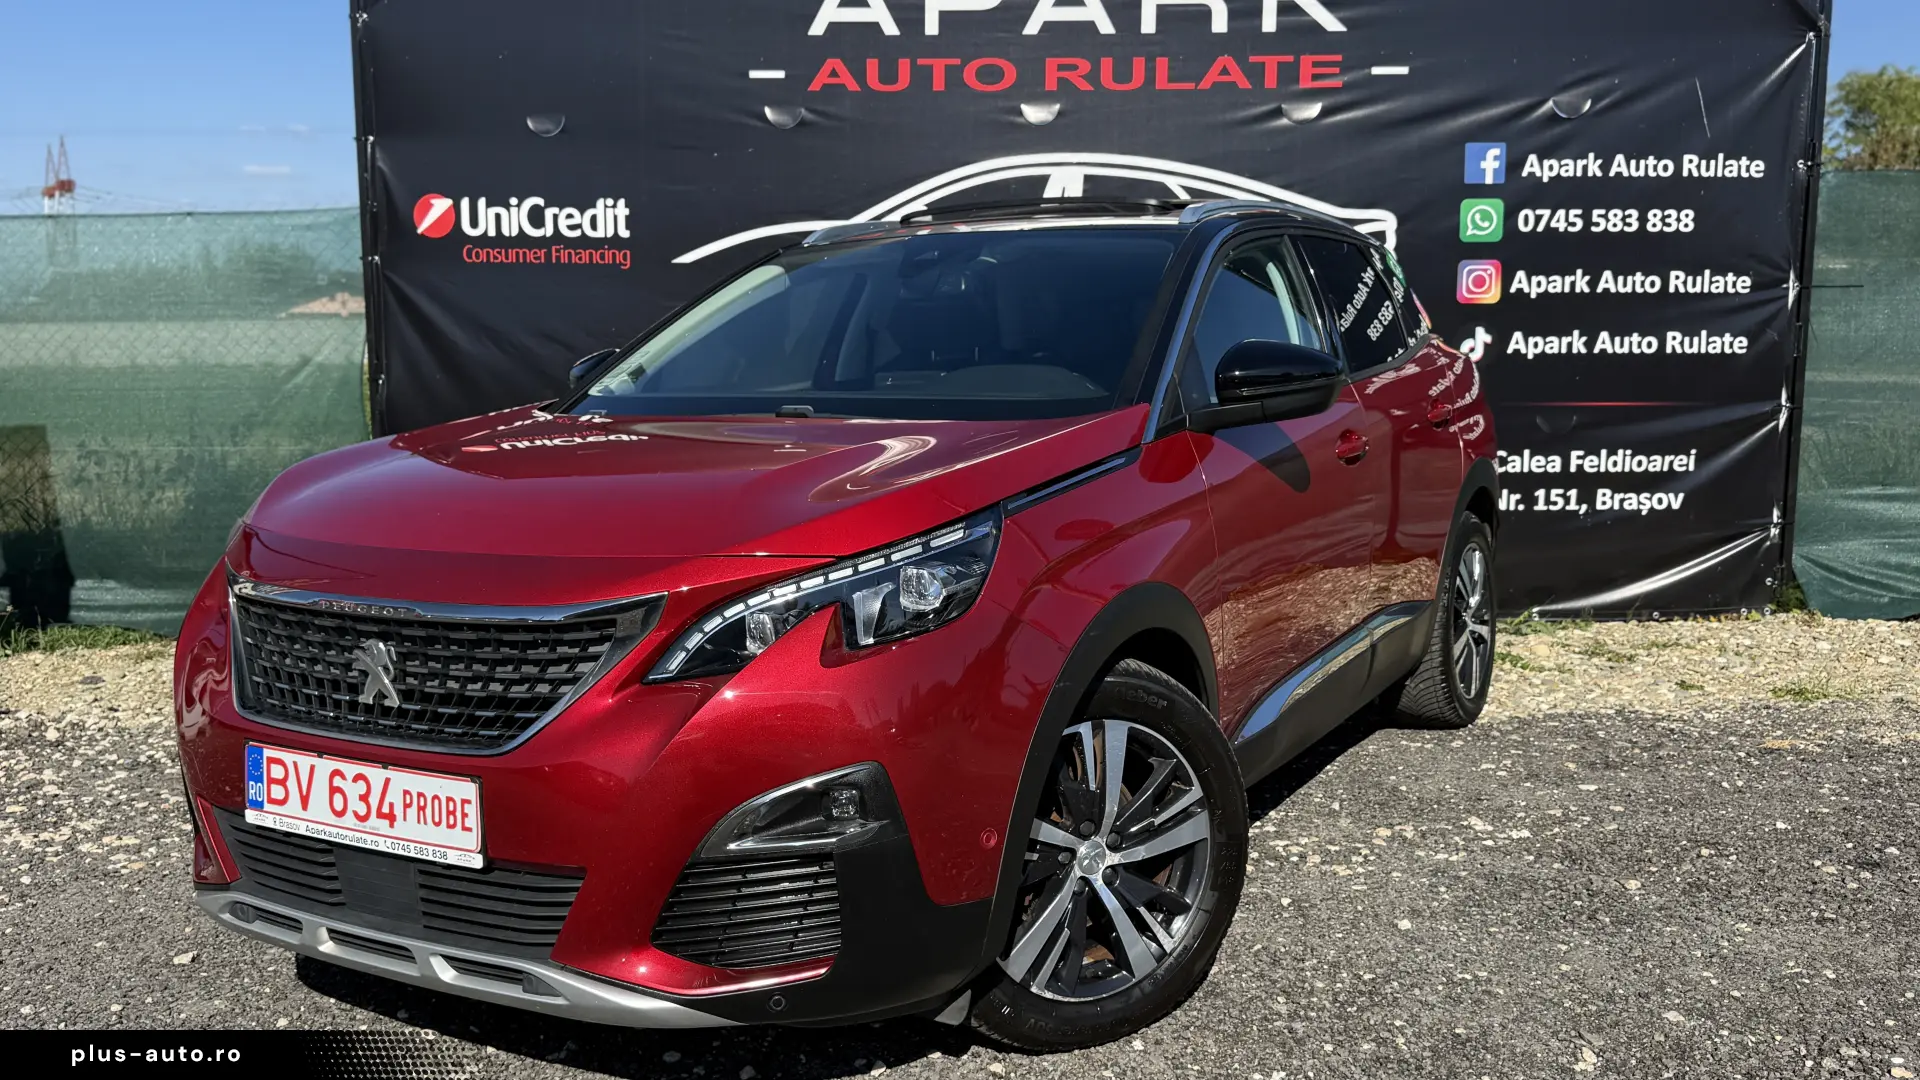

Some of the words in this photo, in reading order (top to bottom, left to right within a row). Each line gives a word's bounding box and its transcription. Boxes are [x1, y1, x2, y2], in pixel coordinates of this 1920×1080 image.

[807, 57, 1017, 92] AUTO
[1044, 54, 1344, 91] RULATE
[1521, 152, 1603, 182] Apark
[1608, 153, 1675, 178] Auto
[1682, 152, 1766, 178] Rulate
[460, 196, 631, 239] UniCredit
[1517, 208, 1584, 233] 0745
[1590, 208, 1640, 233] 583
[1646, 208, 1696, 233] 838
[463, 244, 548, 264] Consumer
[551, 245, 631, 270] Financing
[1509, 268, 1591, 298] Apark
[1596, 270, 1662, 294] Auto
[1668, 269, 1752, 294] Rulate
[1506, 330, 1588, 359] Apark
[1593, 331, 1659, 355] Auto
[1665, 330, 1749, 355] Rulate
[1496, 448, 1562, 474] Calea
[1569, 448, 1698, 474] Feldioarei
[1533, 488, 1589, 515] 151,
[1595, 488, 1685, 515] Brașov
[321, 600, 408, 618] PEUGEOT
[248, 781, 264, 802] RO
[266, 755, 316, 812] BV
[328, 768, 397, 829] 634
[402, 789, 473, 833] PROBE
[305, 824, 380, 849] Aparkautorulate.ro
[390, 841, 412, 855] 0745
[413, 846, 430, 858] 583
[431, 849, 448, 861] 838
